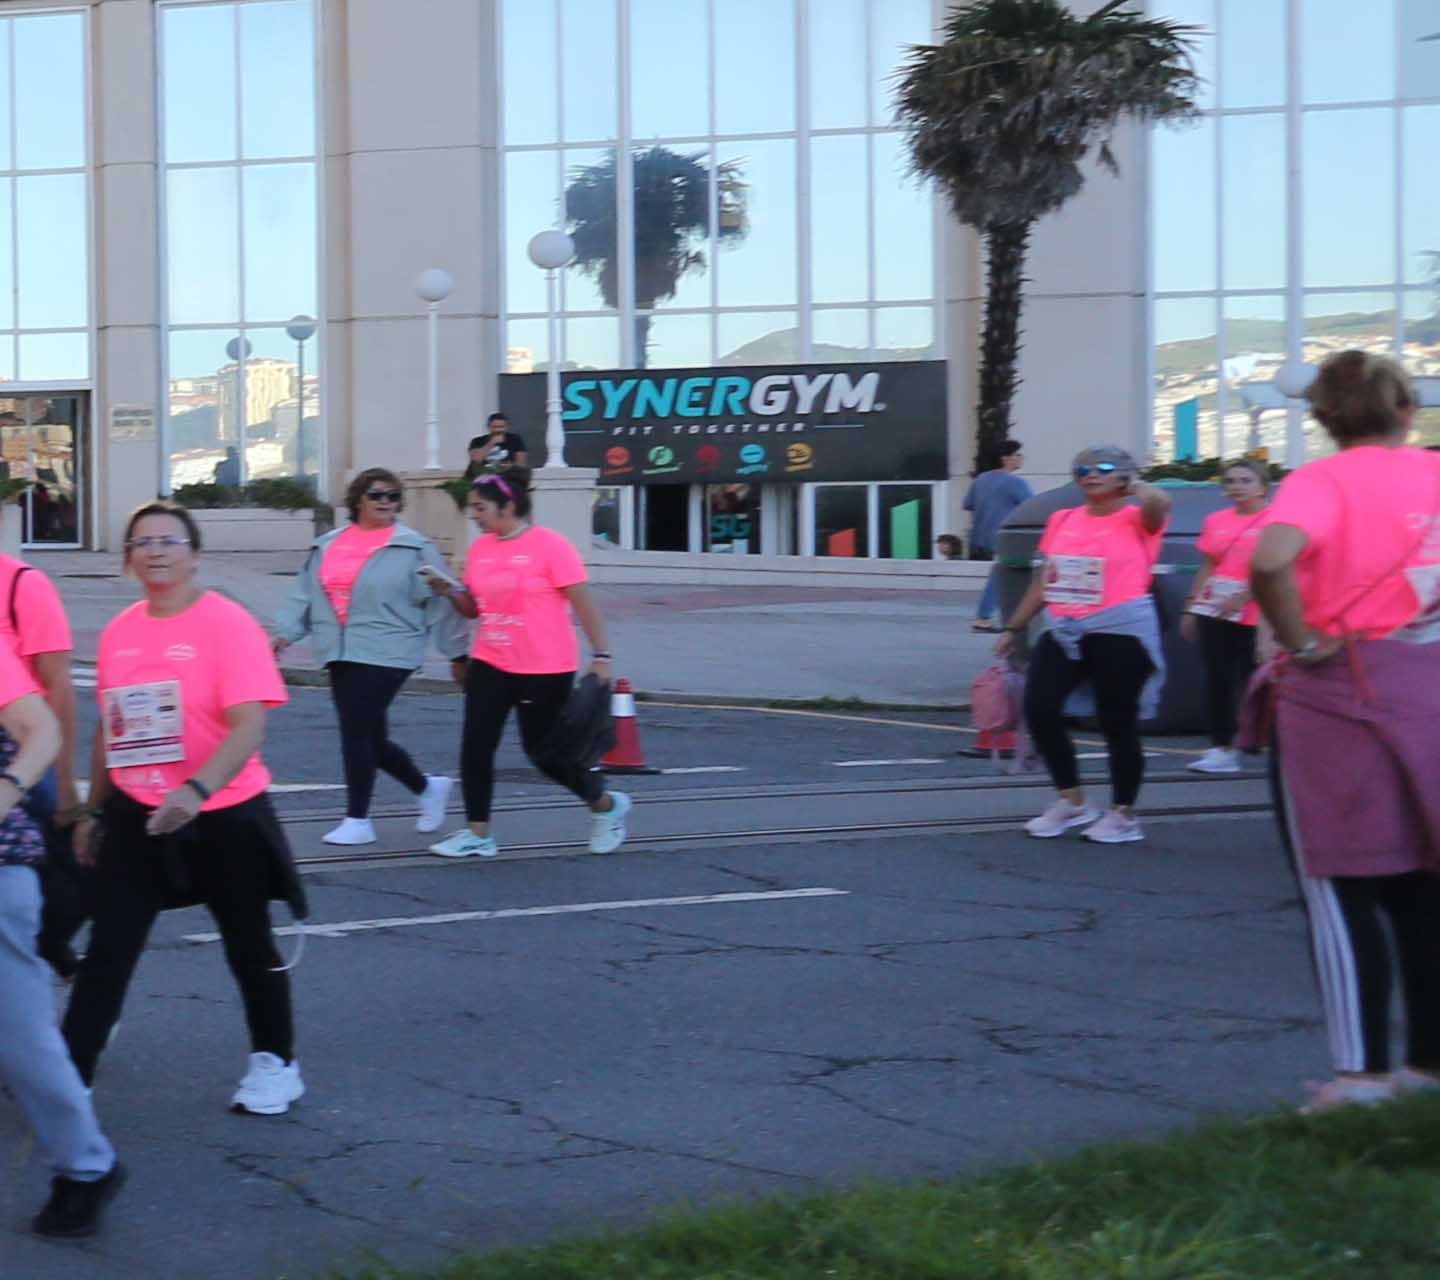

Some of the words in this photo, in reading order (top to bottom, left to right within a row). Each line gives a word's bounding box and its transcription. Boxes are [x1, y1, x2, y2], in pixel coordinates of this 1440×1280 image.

[562, 372, 880, 421] SYNERGYM
[612, 425, 654, 436] FIT
[672, 422, 806, 435] TOGETHER
